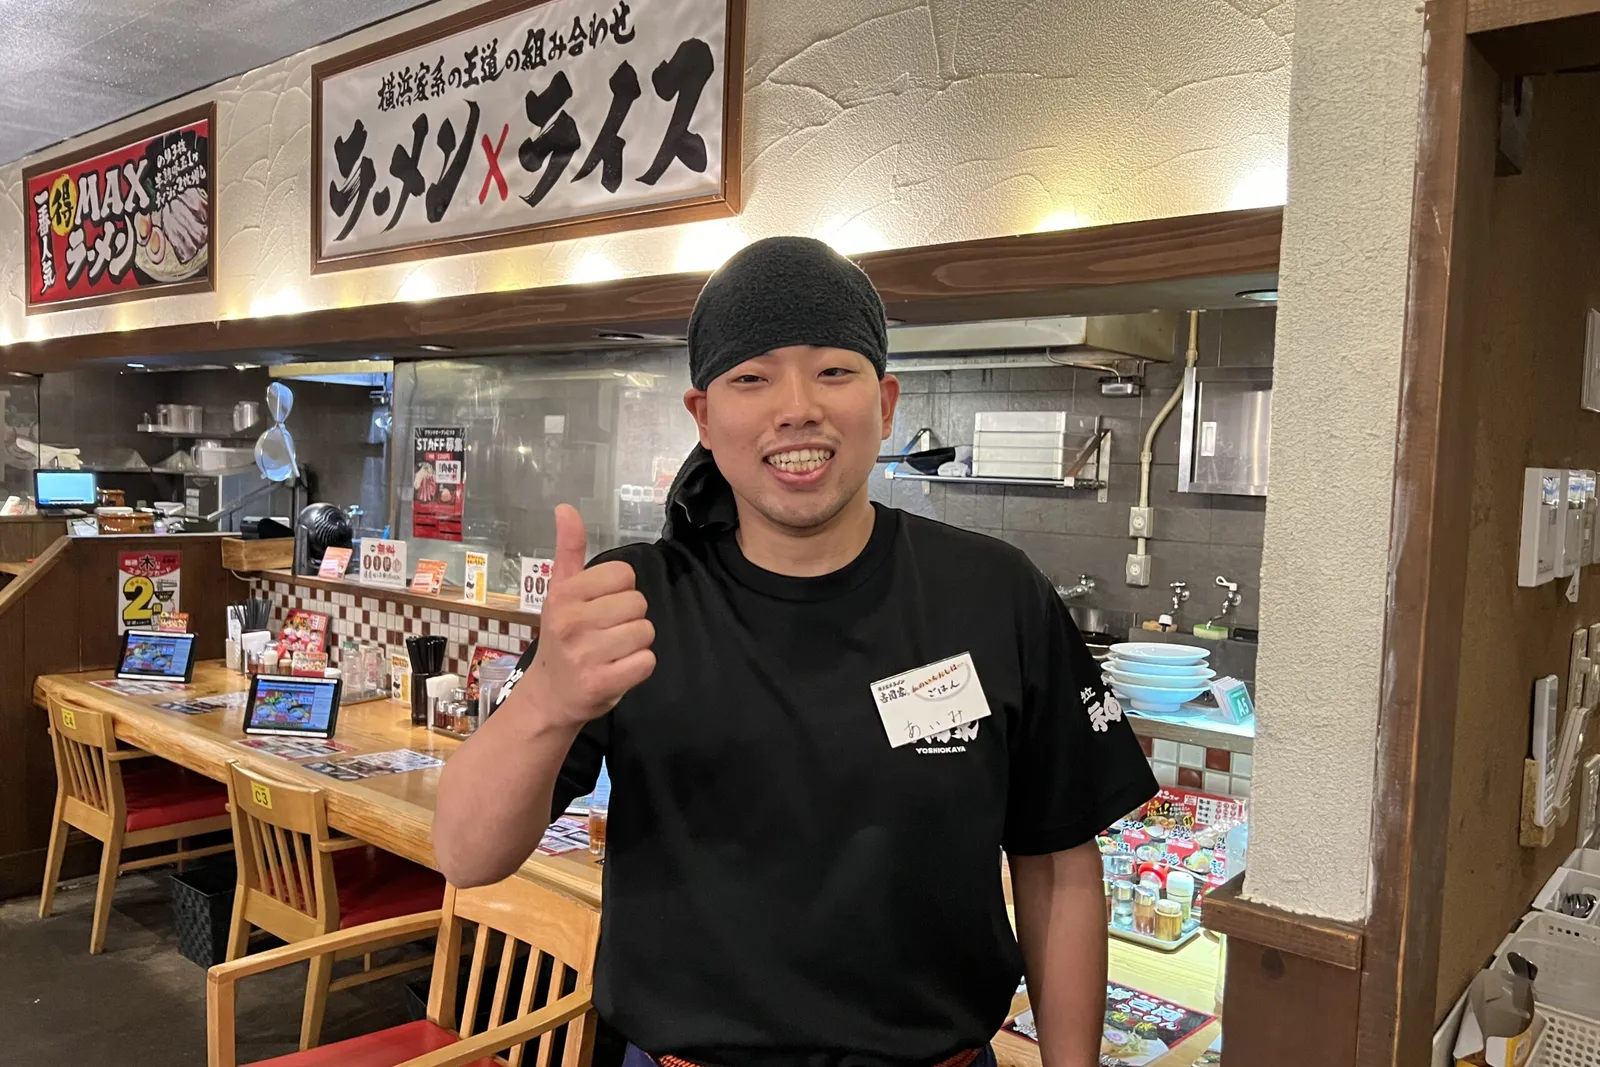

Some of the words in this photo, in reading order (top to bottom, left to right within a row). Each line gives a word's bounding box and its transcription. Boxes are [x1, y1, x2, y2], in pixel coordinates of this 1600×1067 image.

[378, 1, 637, 112] 横浜家系の王道の組み合わせ
[51, 178, 74, 228] 得
[75, 159, 149, 225] MAX
[34, 190, 56, 295] 一番人気
[66, 215, 135, 282] ラーメン
[123, 575, 154, 621] 2
[928, 680, 960, 698] ごはん
[1237, 697, 1249, 716] A5
[915, 745, 966, 754] YOSHIOKAYA
[256, 790, 268, 805] C3
